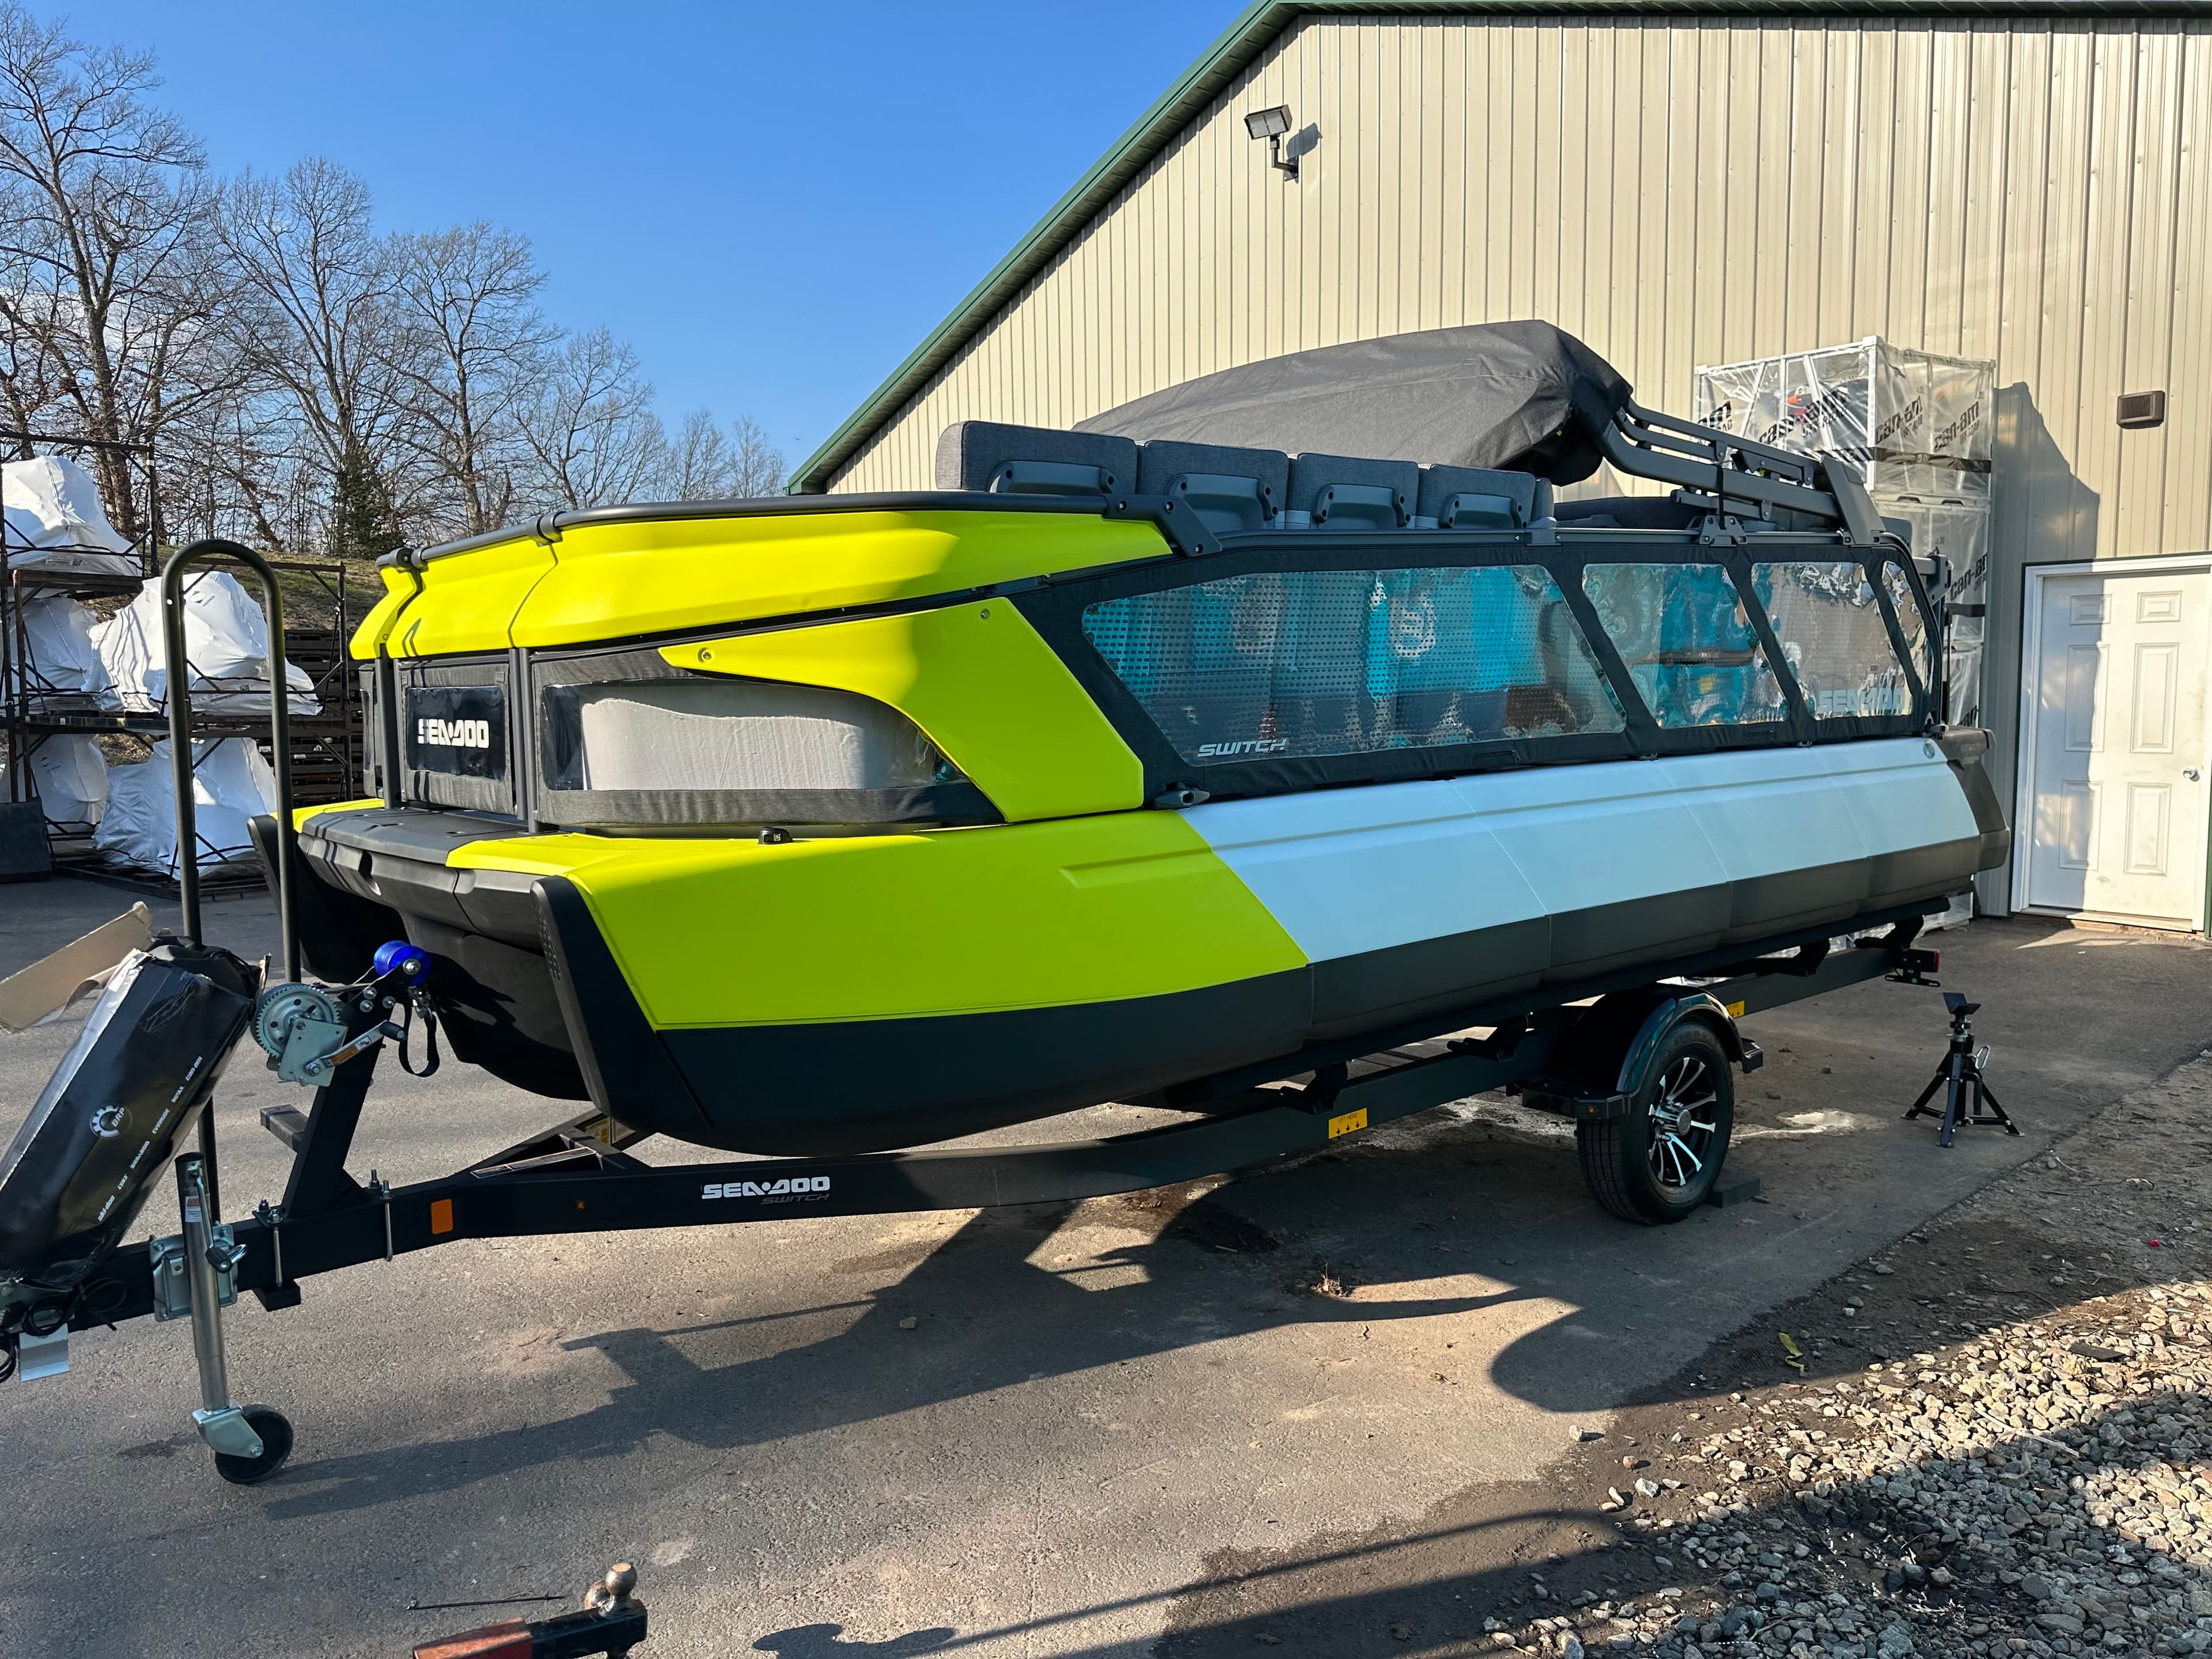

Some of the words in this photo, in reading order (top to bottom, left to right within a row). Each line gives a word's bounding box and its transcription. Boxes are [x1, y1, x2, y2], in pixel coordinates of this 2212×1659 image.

[1934, 401, 1979, 452] can-am
[1197, 739, 1286, 757] SWITCH
[111, 1107, 125, 1127] BRP
[117, 1173, 128, 1190] LYNX
[152, 1108, 170, 1134] EVINRUDE
[171, 1086, 184, 1103] ROTAX
[185, 1056, 202, 1081] can-am
[760, 1194, 830, 1205] SWITCH
